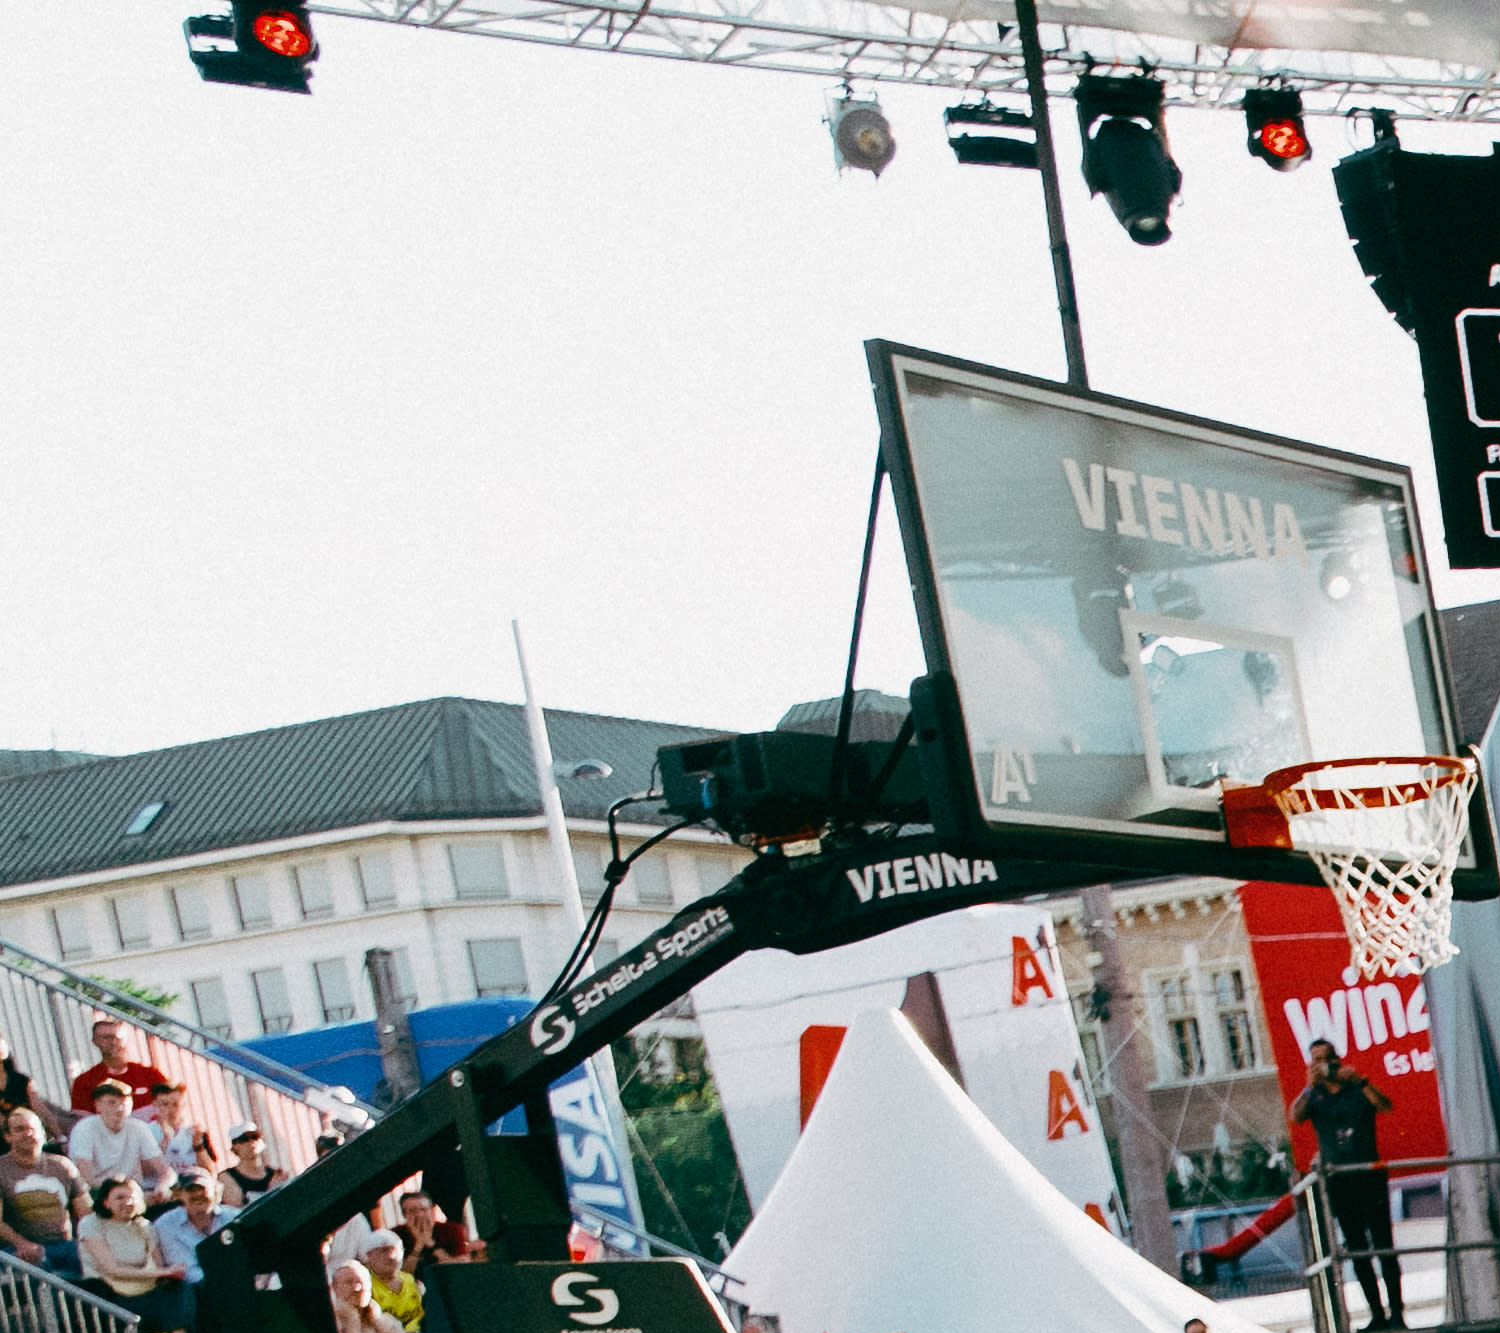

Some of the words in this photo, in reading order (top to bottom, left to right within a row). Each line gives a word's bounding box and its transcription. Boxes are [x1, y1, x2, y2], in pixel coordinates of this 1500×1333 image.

[1062, 457, 1309, 567] VIENNA
[846, 851, 1000, 904] VIENNA
[656, 904, 730, 962] Sports
